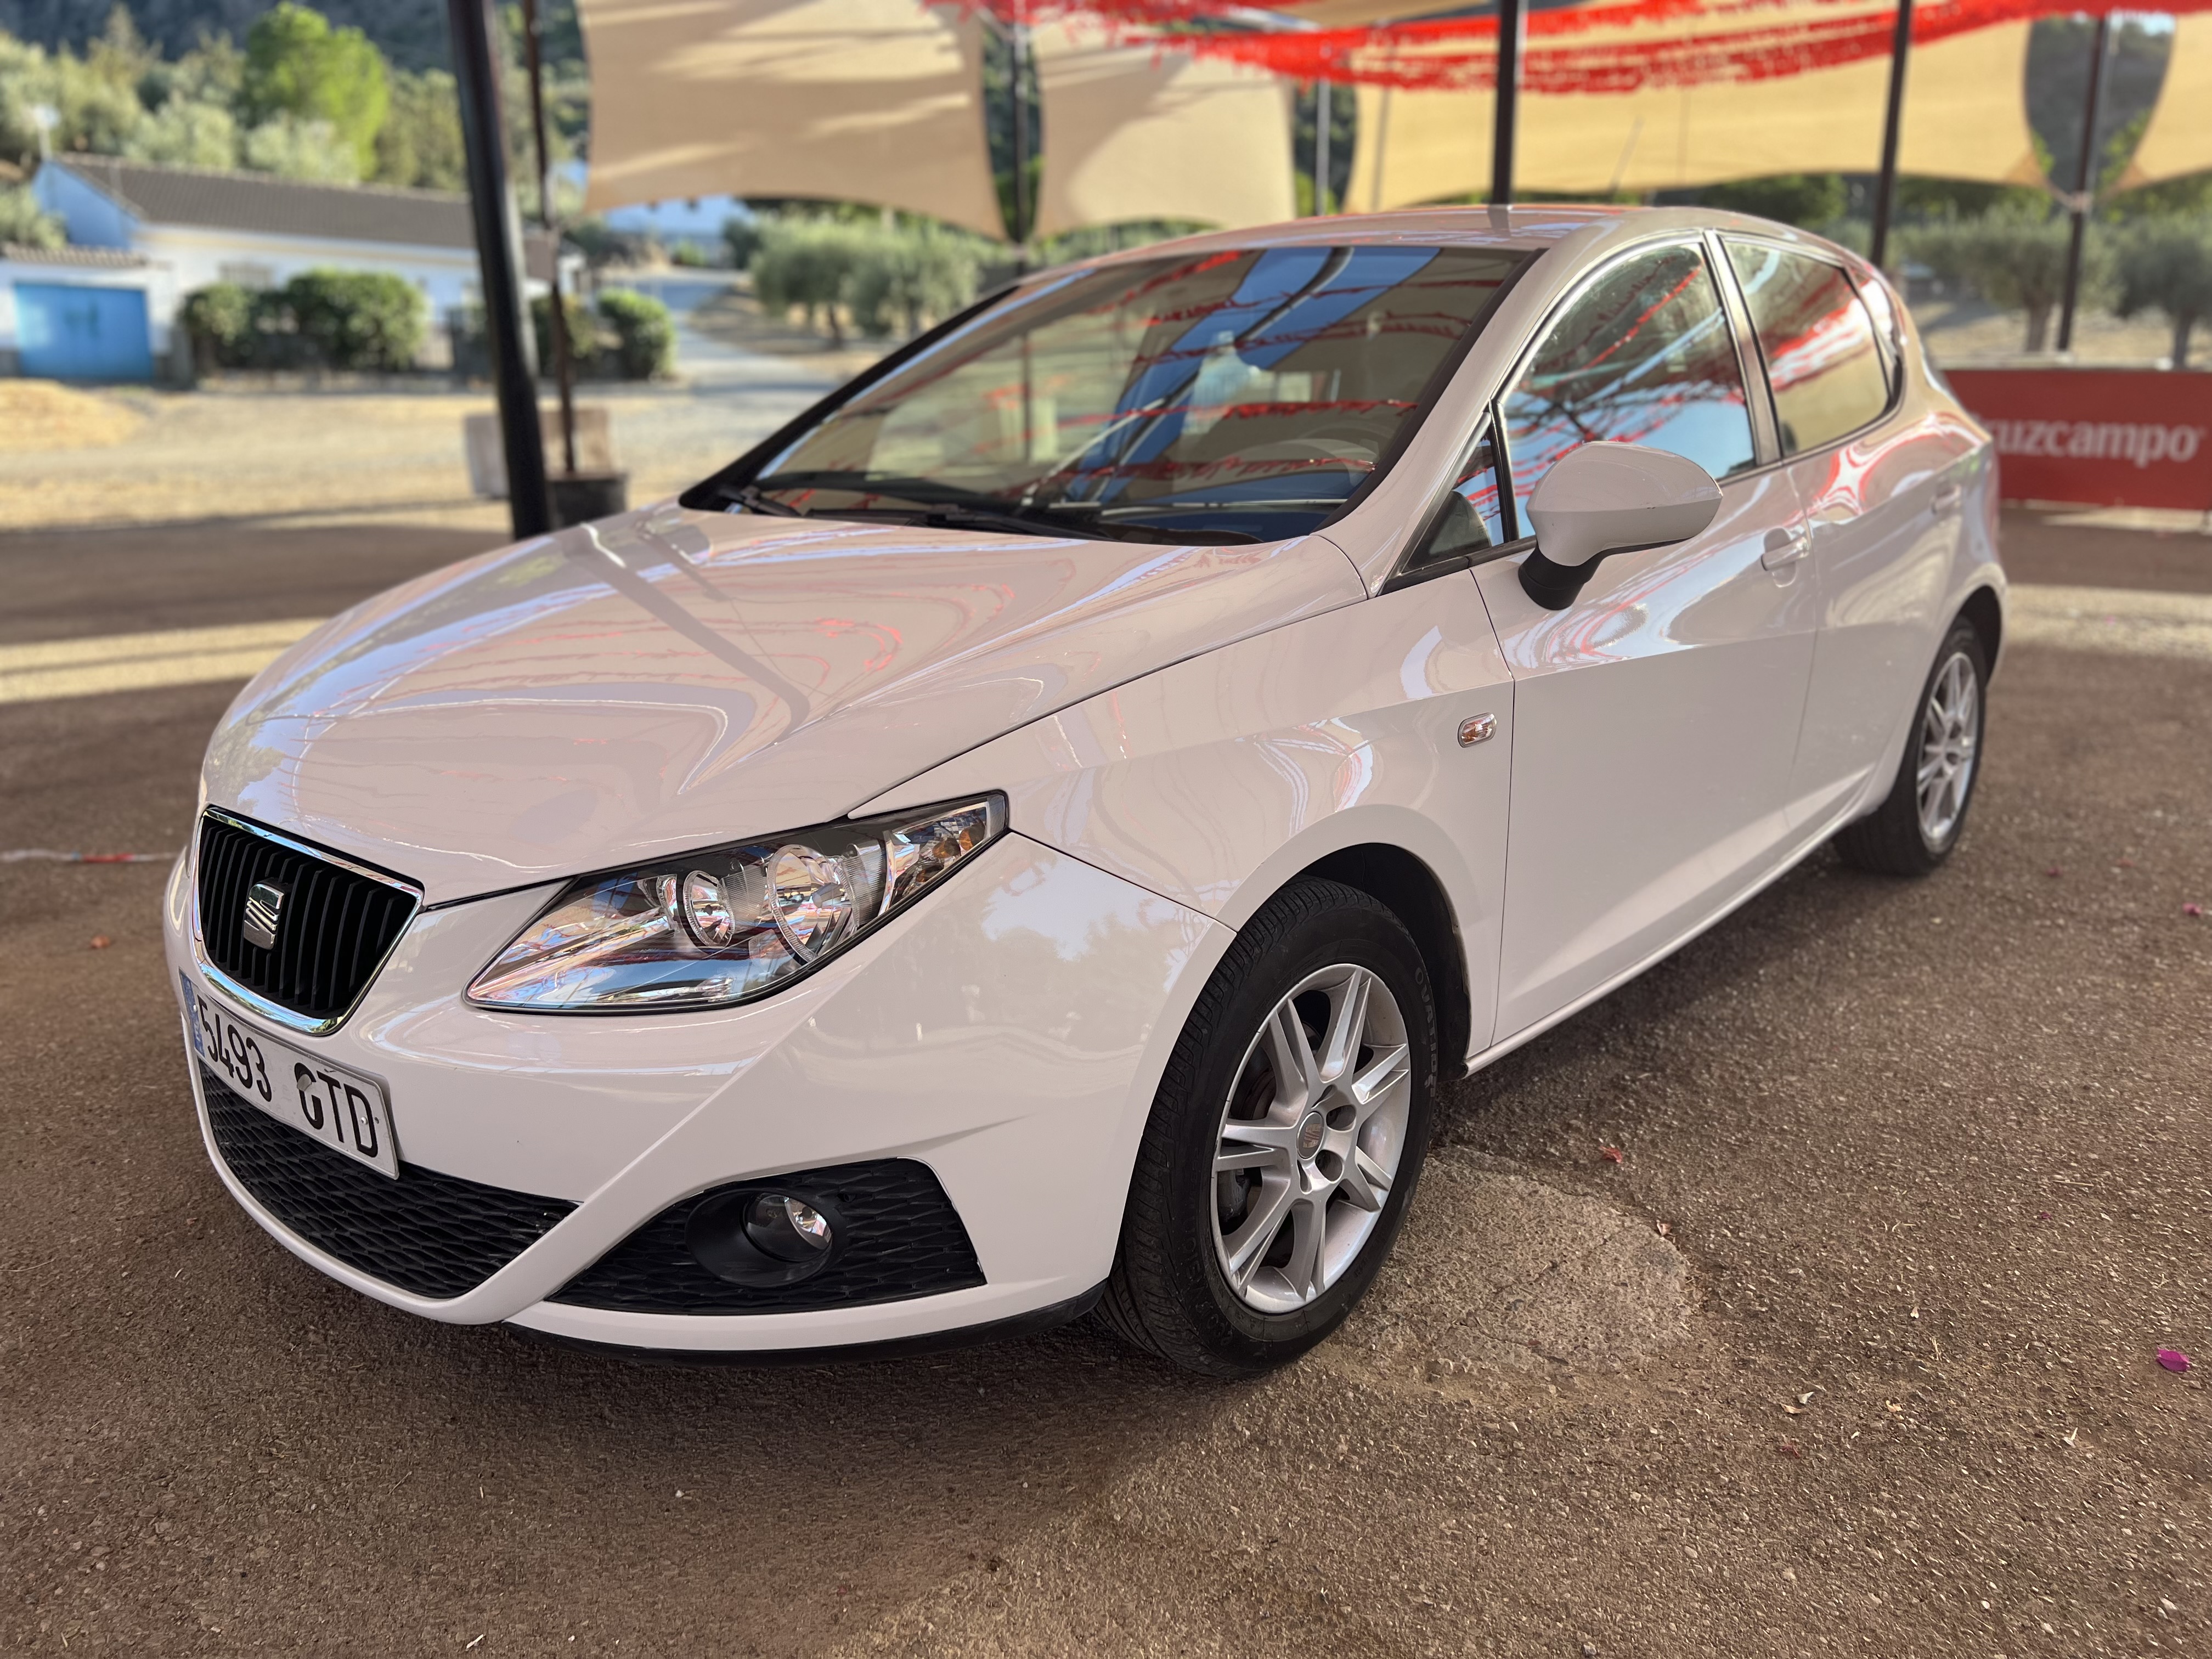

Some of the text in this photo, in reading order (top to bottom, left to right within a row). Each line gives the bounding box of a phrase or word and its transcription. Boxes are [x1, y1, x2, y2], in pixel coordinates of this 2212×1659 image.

[1973, 414, 2200, 469] uzcampo
[197, 995, 379, 1158] 5493 GTD
